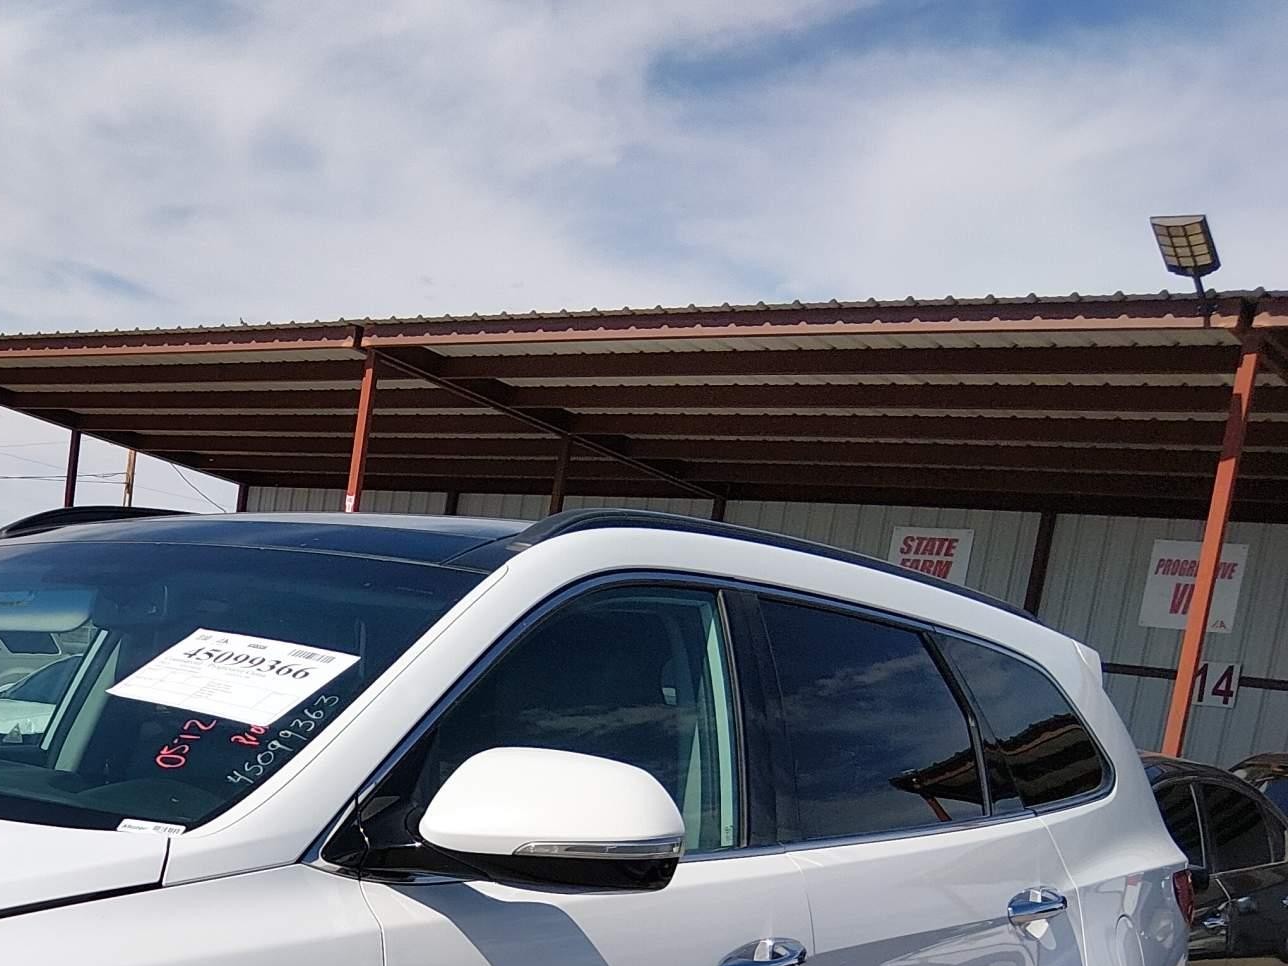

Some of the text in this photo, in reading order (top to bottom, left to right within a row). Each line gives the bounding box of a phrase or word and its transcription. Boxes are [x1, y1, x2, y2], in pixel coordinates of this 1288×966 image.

[899, 535, 960, 557] STATE
[183, 647, 318, 680] 45099366
[1194, 663, 1235, 705] 14
[226, 694, 340, 785] 45099363
